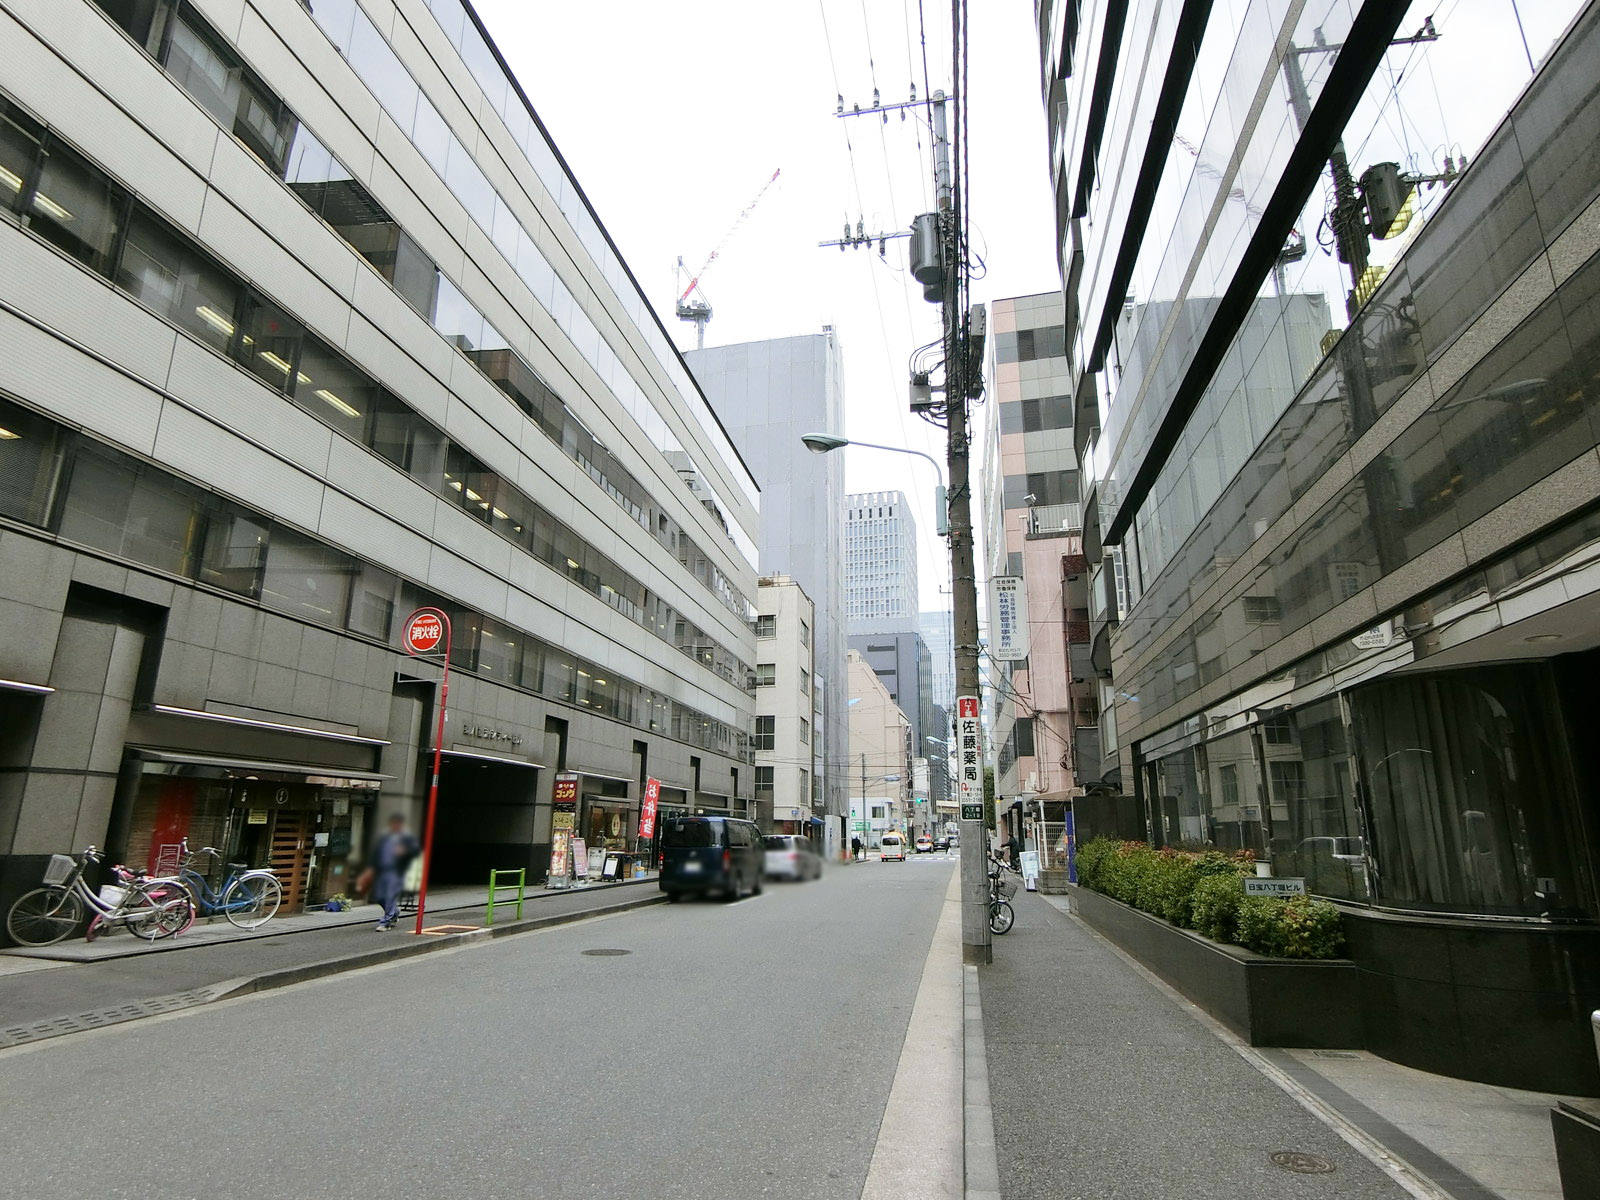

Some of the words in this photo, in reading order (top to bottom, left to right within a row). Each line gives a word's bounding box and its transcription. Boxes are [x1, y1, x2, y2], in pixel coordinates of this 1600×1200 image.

[412, 624, 440, 640] 消火栓
[999, 592, 1011, 647] 松林労務管理事務所
[962, 720, 977, 781] 佐藤薬局
[643, 784, 657, 834] お弁当
